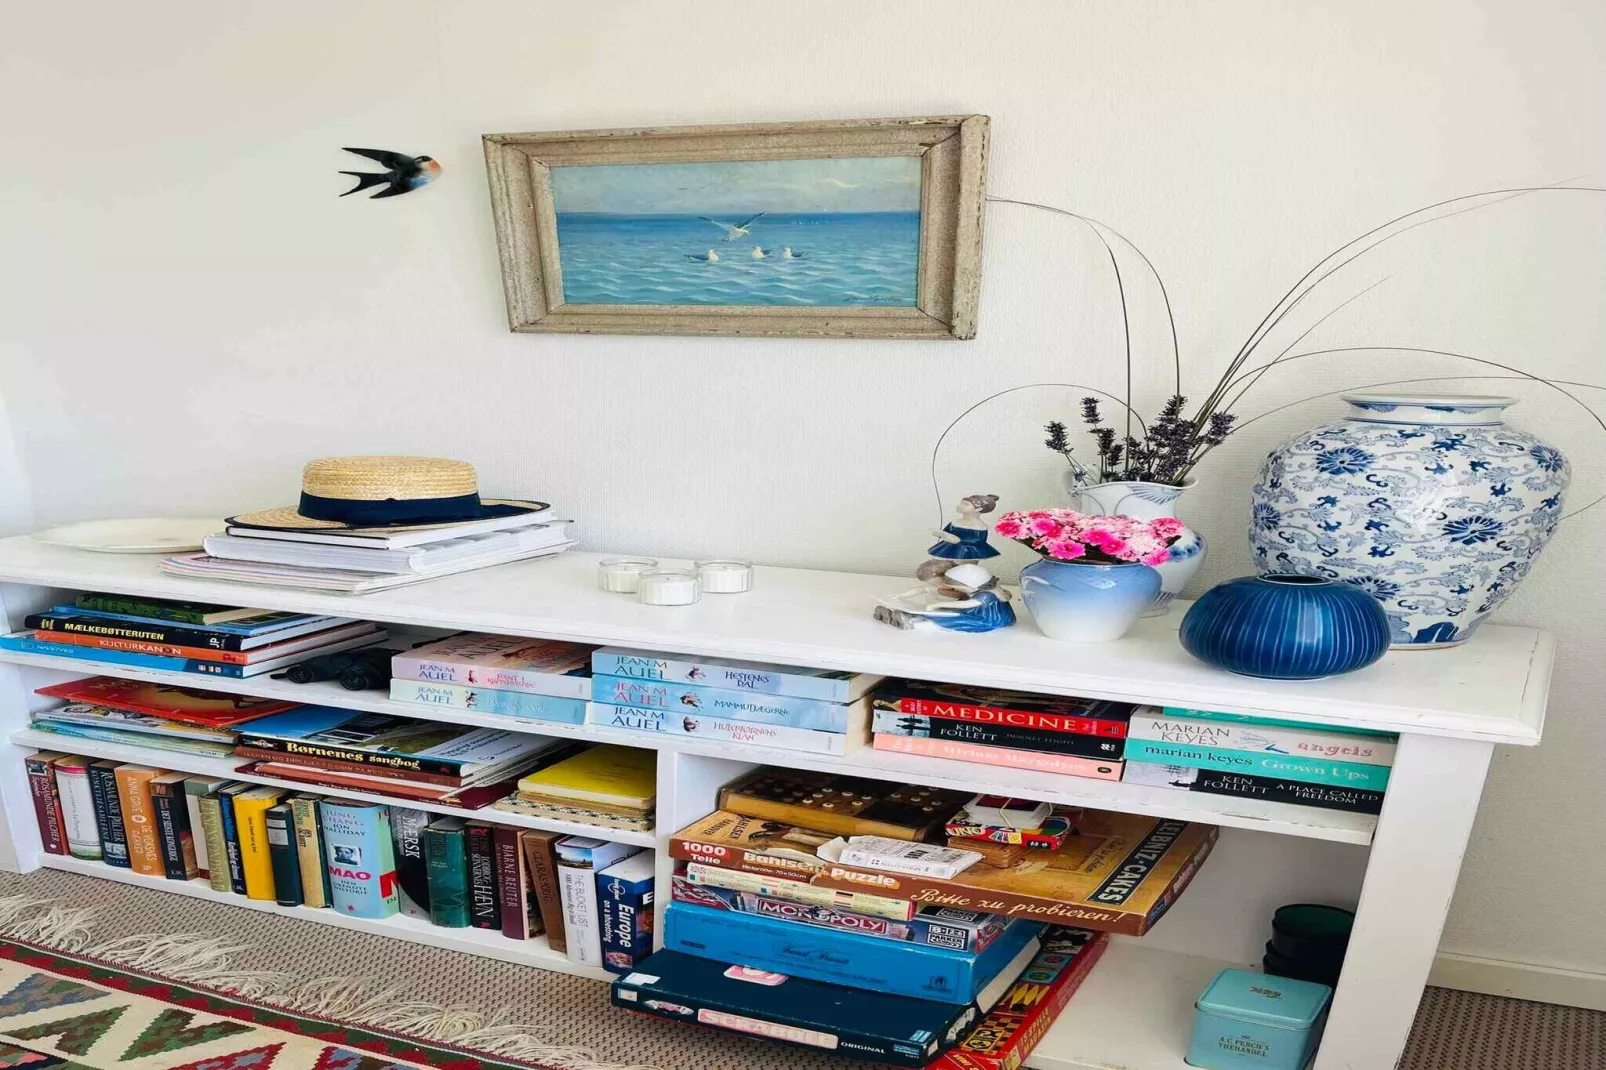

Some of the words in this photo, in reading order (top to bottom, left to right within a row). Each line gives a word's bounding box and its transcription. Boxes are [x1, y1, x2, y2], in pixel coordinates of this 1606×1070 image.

[64, 623, 164, 640] MÆLKEBØTTERUTEN
[99, 639, 181, 654] KULTURKANON
[209, 637, 220, 648] JP
[419, 664, 444, 673] JEAN
[445, 666, 455, 674] M
[616, 656, 650, 667] JEAN
[651, 660, 668, 669] M
[418, 671, 458, 682] AUEL
[614, 665, 671, 681] AUEL
[725, 670, 770, 683] HESTENES
[417, 687, 442, 696] JEAN
[443, 689, 453, 697] M
[616, 681, 650, 692] JEAN
[651, 686, 668, 696] M
[736, 680, 760, 689] DAL
[415, 693, 454, 705] AUEL
[613, 691, 671, 708] AUEL
[614, 706, 647, 717] JEAN
[649, 710, 665, 720] M
[933, 705, 1077, 731] MEDICINE
[611, 714, 667, 731] AUEL
[956, 724, 983, 733] KEN
[1152, 721, 1230, 737] MARIAN
[940, 728, 998, 742] FOLLETT
[1161, 731, 1219, 746] KEYES
[286, 742, 364, 761] Børnenes
[1145, 745, 1202, 760] marian
[1207, 751, 1253, 767] keyes
[1297, 742, 1373, 758] angels
[1261, 759, 1326, 775] Grown
[1331, 767, 1370, 780] Ups
[1203, 780, 1271, 795] FOLLETT
[1222, 775, 1253, 785] KEN
[40, 777, 52, 816] ROSAMUNDE
[1288, 784, 1327, 795] PLACE
[1329, 790, 1379, 801] CALLED
[1295, 791, 1357, 804] FREEDOM
[323, 826, 366, 836] HALLIDAY
[402, 816, 420, 859] MÆRSK
[948, 828, 983, 837] UNO
[682, 841, 727, 856] 1000
[502, 844, 516, 874] BJARNE
[329, 865, 371, 881] MAO
[831, 868, 897, 886] Puzzle
[575, 875, 584, 887] THE
[1096, 864, 1139, 904] CAKES
[507, 876, 519, 908] REUTER
[474, 885, 494, 918] HÆVN
[577, 887, 588, 913] BUCKET
[603, 899, 610, 909] on
[910, 889, 971, 906] Bitte
[977, 899, 1006, 909] zu
[1007, 902, 1124, 923] probieren!
[580, 913, 589, 928] LIST
[618, 903, 635, 949] Europe
[602, 914, 612, 944] shoestring
[840, 1041, 886, 1054] ORIGINAL
